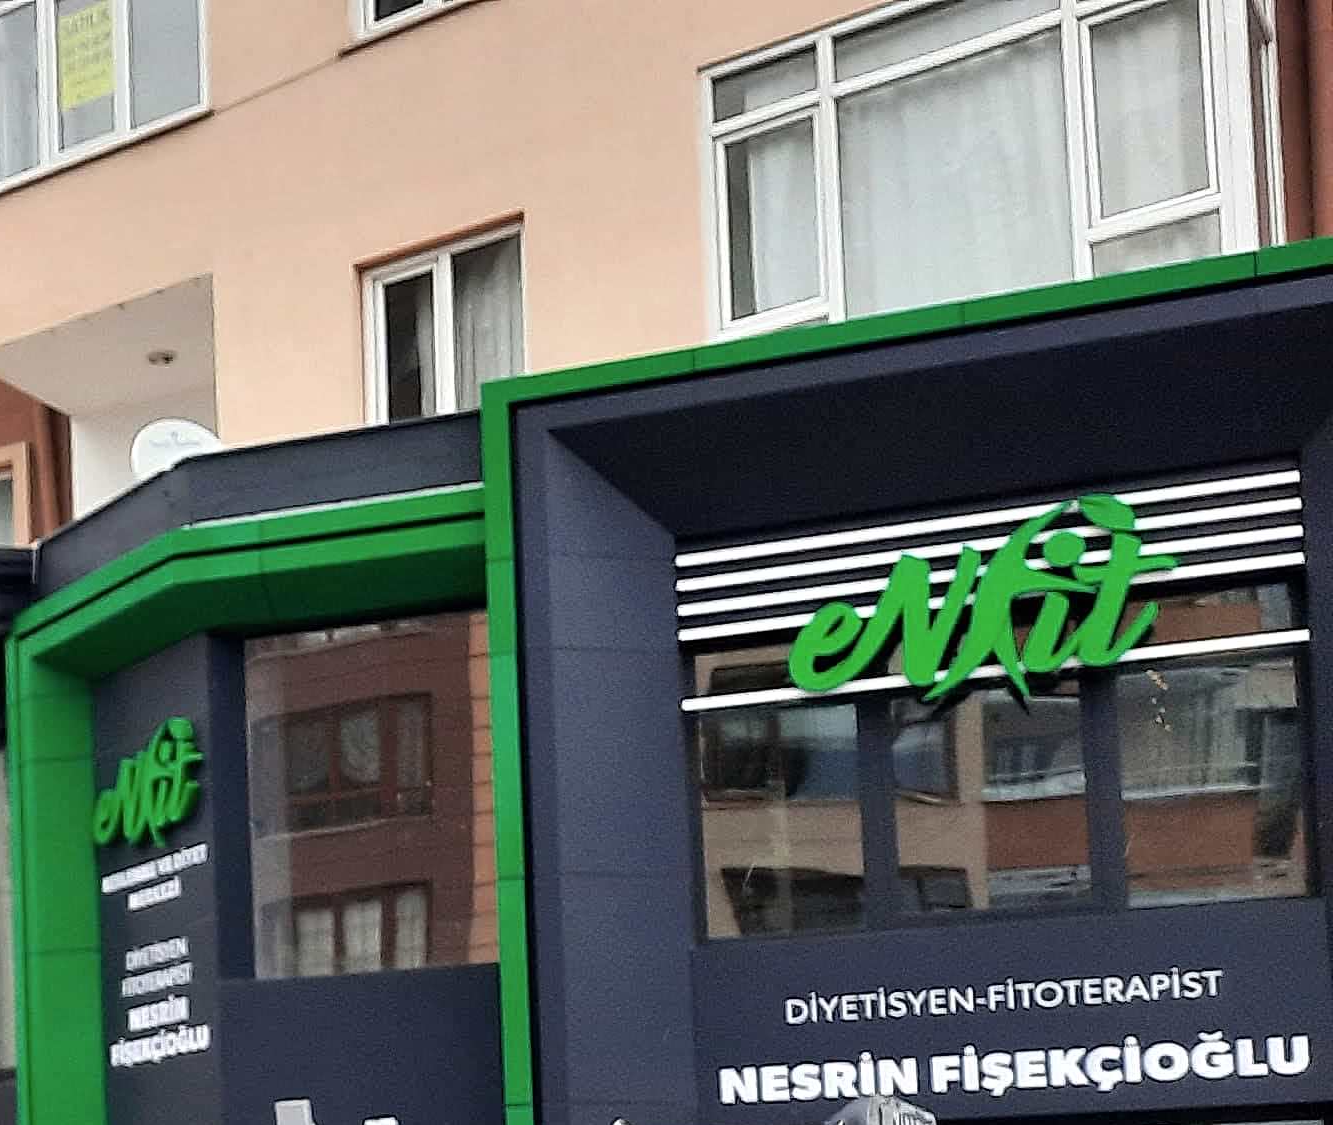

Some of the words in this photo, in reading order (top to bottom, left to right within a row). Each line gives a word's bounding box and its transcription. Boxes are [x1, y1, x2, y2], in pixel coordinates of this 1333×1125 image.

[784, 966, 1223, 1026] DİYETİSYEN-FİTOTERAPİST
[718, 1051, 919, 1105] NESRİN
[930, 1030, 1312, 1098] FİŞEKÇİOĞLU
